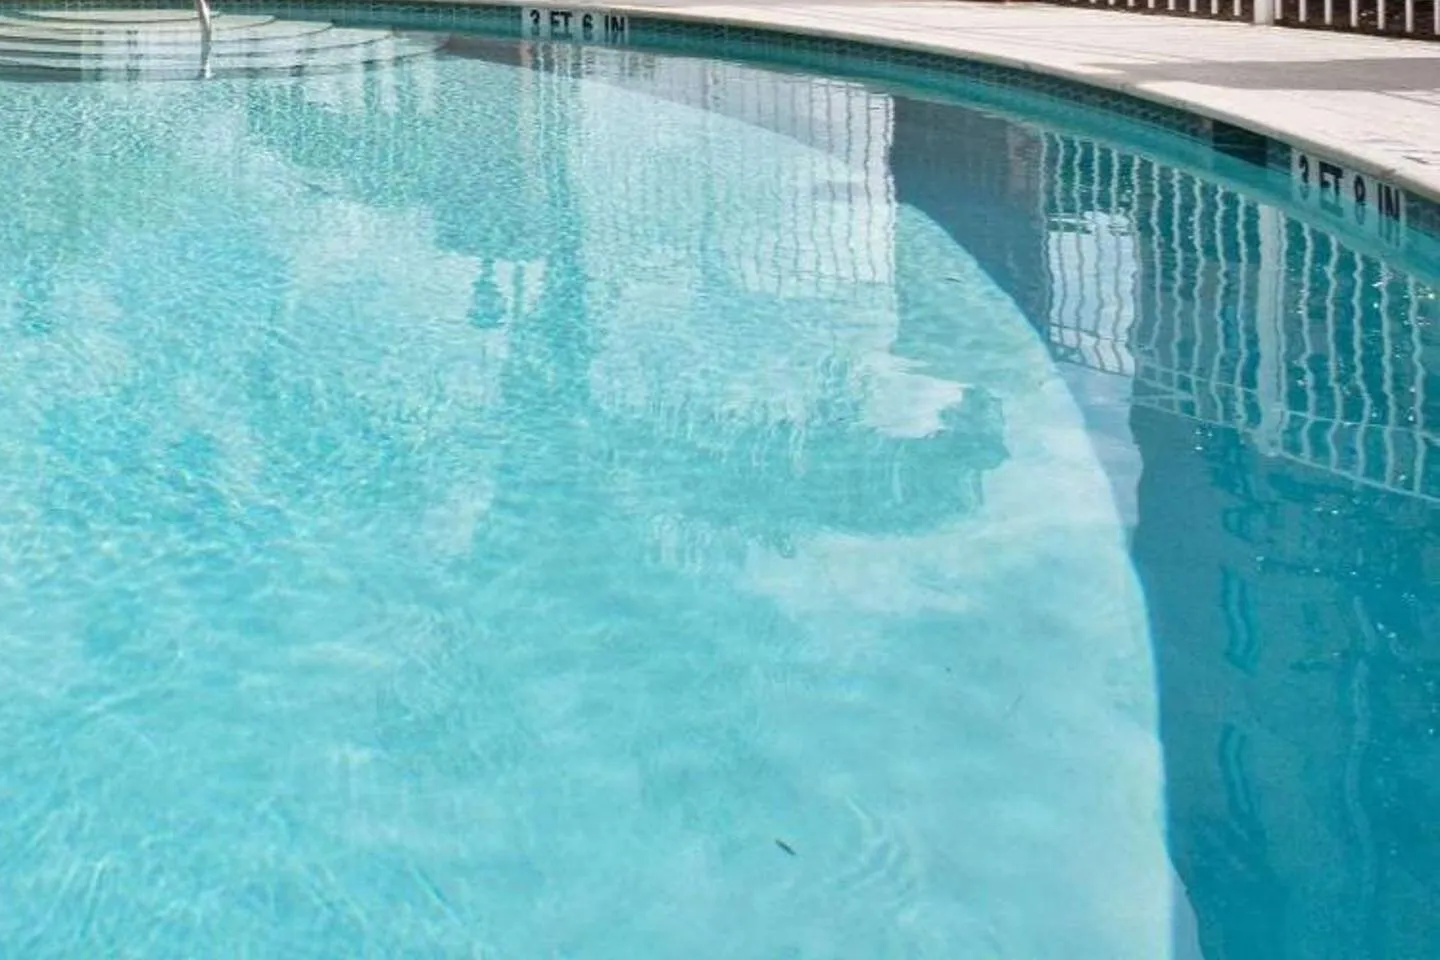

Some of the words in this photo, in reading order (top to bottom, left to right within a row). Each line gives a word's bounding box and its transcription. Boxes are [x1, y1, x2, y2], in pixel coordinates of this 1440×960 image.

[550, 11, 573, 27] FT
[604, 14, 625, 32] IN
[1319, 160, 1344, 196] FT
[1378, 182, 1400, 221] IN
